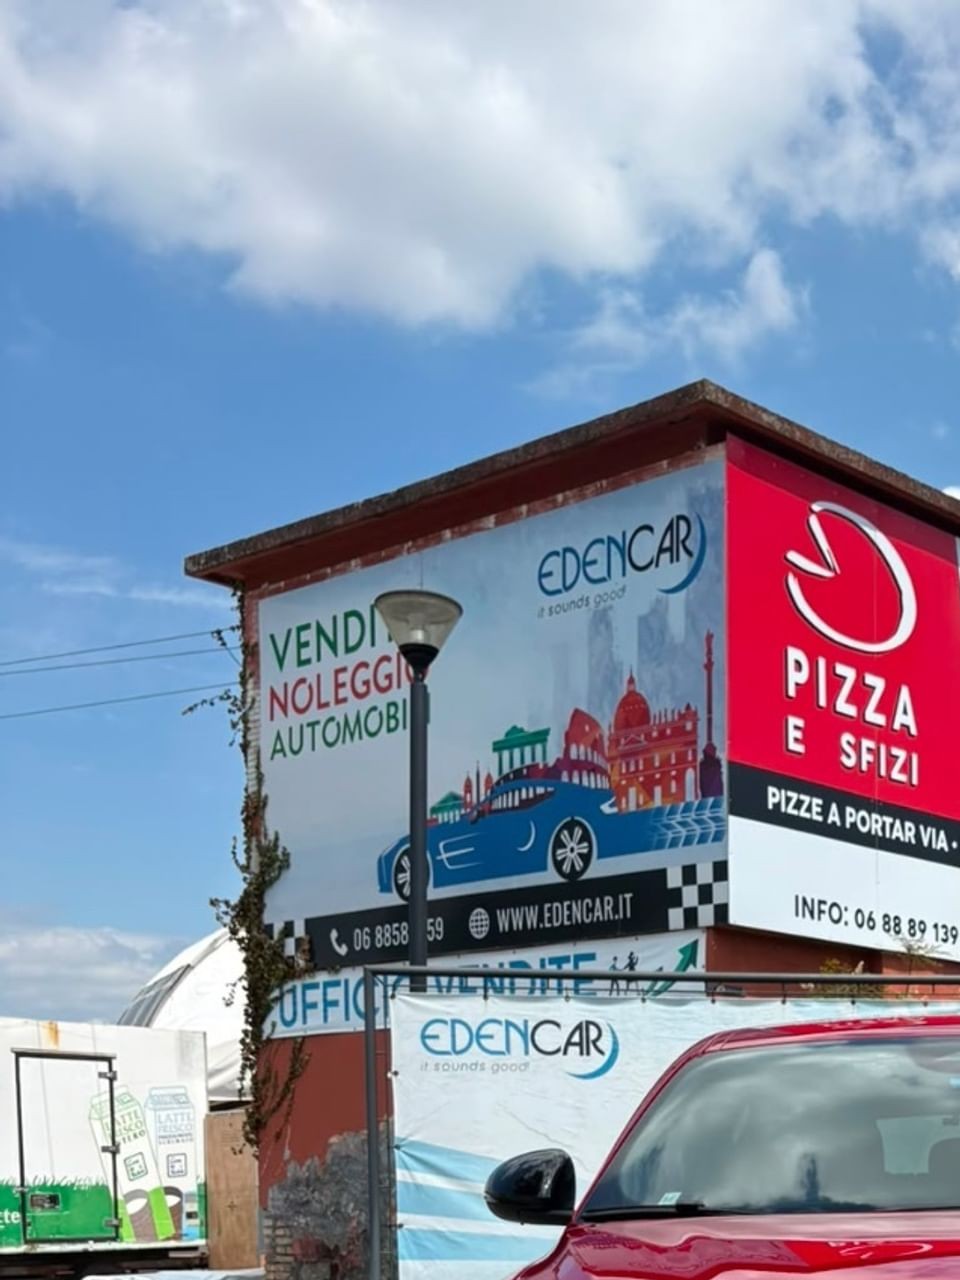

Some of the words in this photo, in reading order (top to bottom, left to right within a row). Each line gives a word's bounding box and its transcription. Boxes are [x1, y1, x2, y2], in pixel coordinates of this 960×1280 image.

[538, 514, 694, 596] EDENCAR
[548, 593, 590, 617] sounds
[269, 604, 393, 672] VENDI
[785, 645, 918, 736] PIZZA
[785, 715, 806, 754] E
[839, 732, 919, 786] SFIZI
[767, 785, 824, 822] PIZZE
[827, 802, 841, 827] A
[845, 806, 917, 845] PORTAR
[919, 824, 949, 852] VIA
[353, 927, 371, 951] 06
[496, 893, 634, 933] WWW.EDENCAR.IT
[794, 894, 849, 927] INFO:
[854, 908, 877, 931] 06
[882, 913, 902, 936] 88
[907, 918, 928, 938] 89
[933, 922, 959, 945] 139
[420, 1018, 605, 1056] EDENCAR
[434, 1061, 486, 1072] sounds
